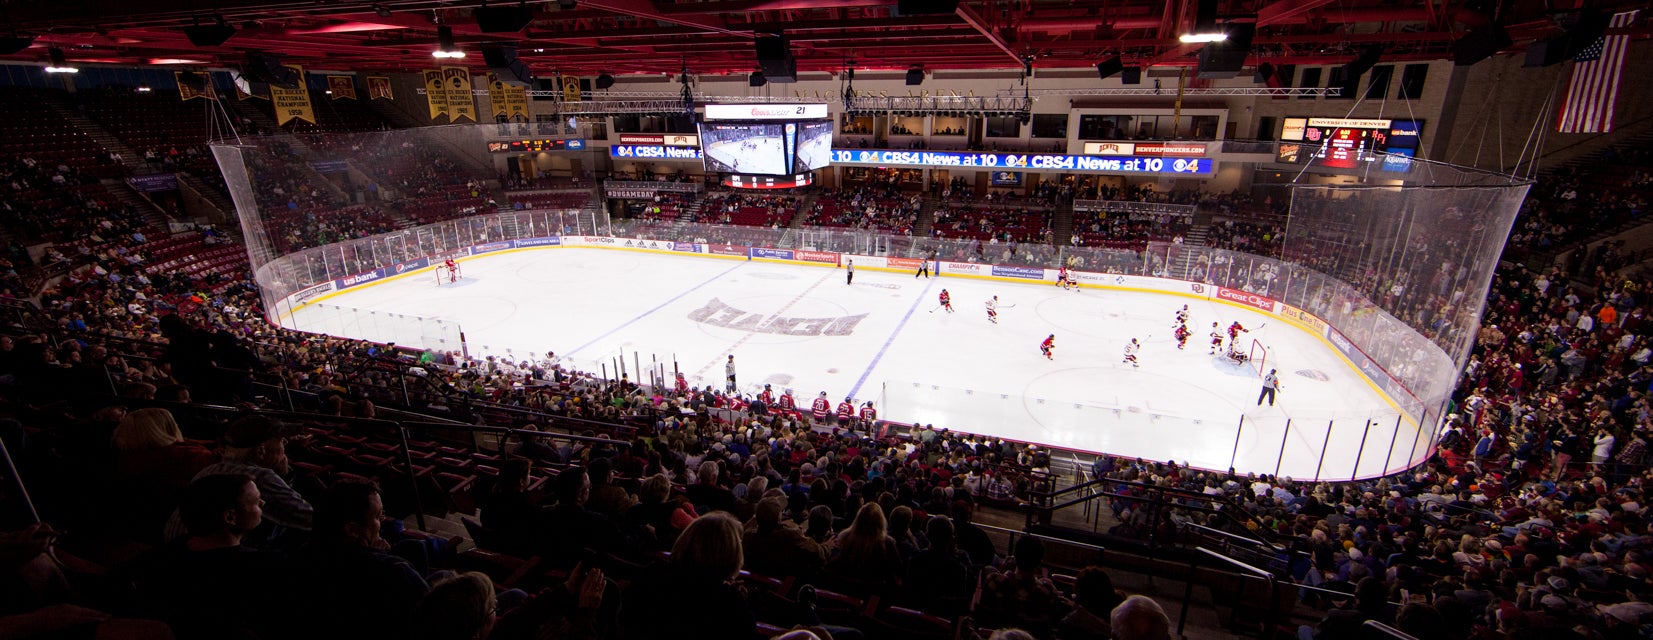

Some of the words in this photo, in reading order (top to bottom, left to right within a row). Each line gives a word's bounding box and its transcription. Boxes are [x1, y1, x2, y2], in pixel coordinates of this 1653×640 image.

[795, 89, 887, 101] MAGESS
[906, 88, 975, 99] ARENA
[796, 106, 805, 114] 21
[636, 146, 664, 157] CBS4
[666, 147, 696, 158] News
[1099, 144, 1120, 152] DENVER
[838, 150, 852, 162] 10
[882, 152, 920, 164] CBS4
[922, 154, 960, 166] News
[964, 155, 977, 166] at
[980, 154, 997, 166] 10
[1032, 156, 1074, 168] CBS4
[1078, 157, 1120, 170] News
[1124, 159, 1140, 171] at
[1144, 158, 1163, 172] 10
[1192, 284, 1204, 294] DU
[1220, 290, 1247, 302] Great
[1248, 295, 1272, 308] Clips
[1281, 306, 1298, 318] Plus
[815, 401, 824, 410] 20
